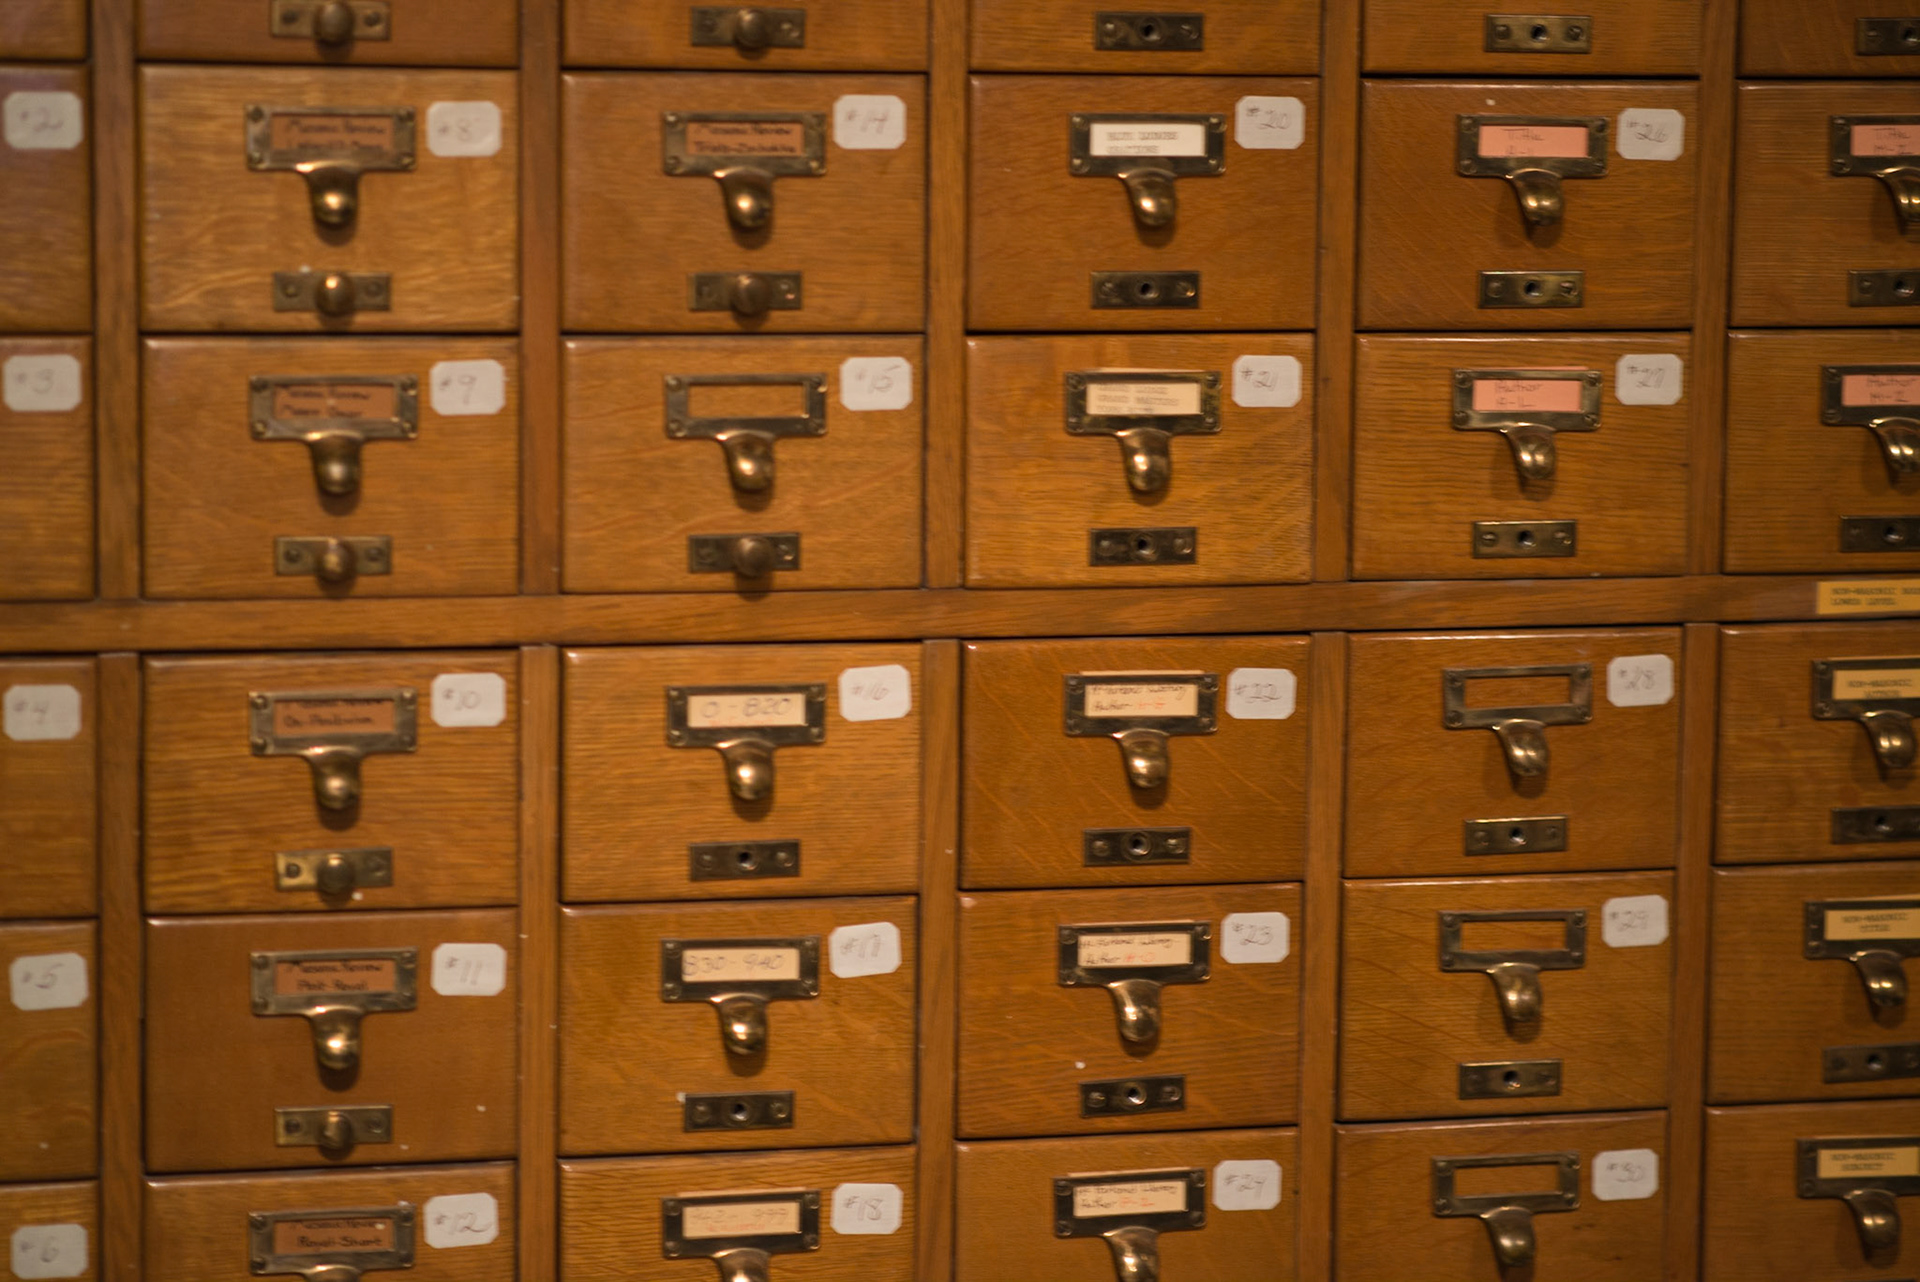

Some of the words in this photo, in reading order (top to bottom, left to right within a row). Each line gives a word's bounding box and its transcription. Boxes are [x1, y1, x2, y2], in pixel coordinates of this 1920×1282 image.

[1241, 367, 1279, 391] #21
[443, 687, 481, 711] #10
[1235, 682, 1282, 703] #22
[435, 1211, 492, 1235] #12
